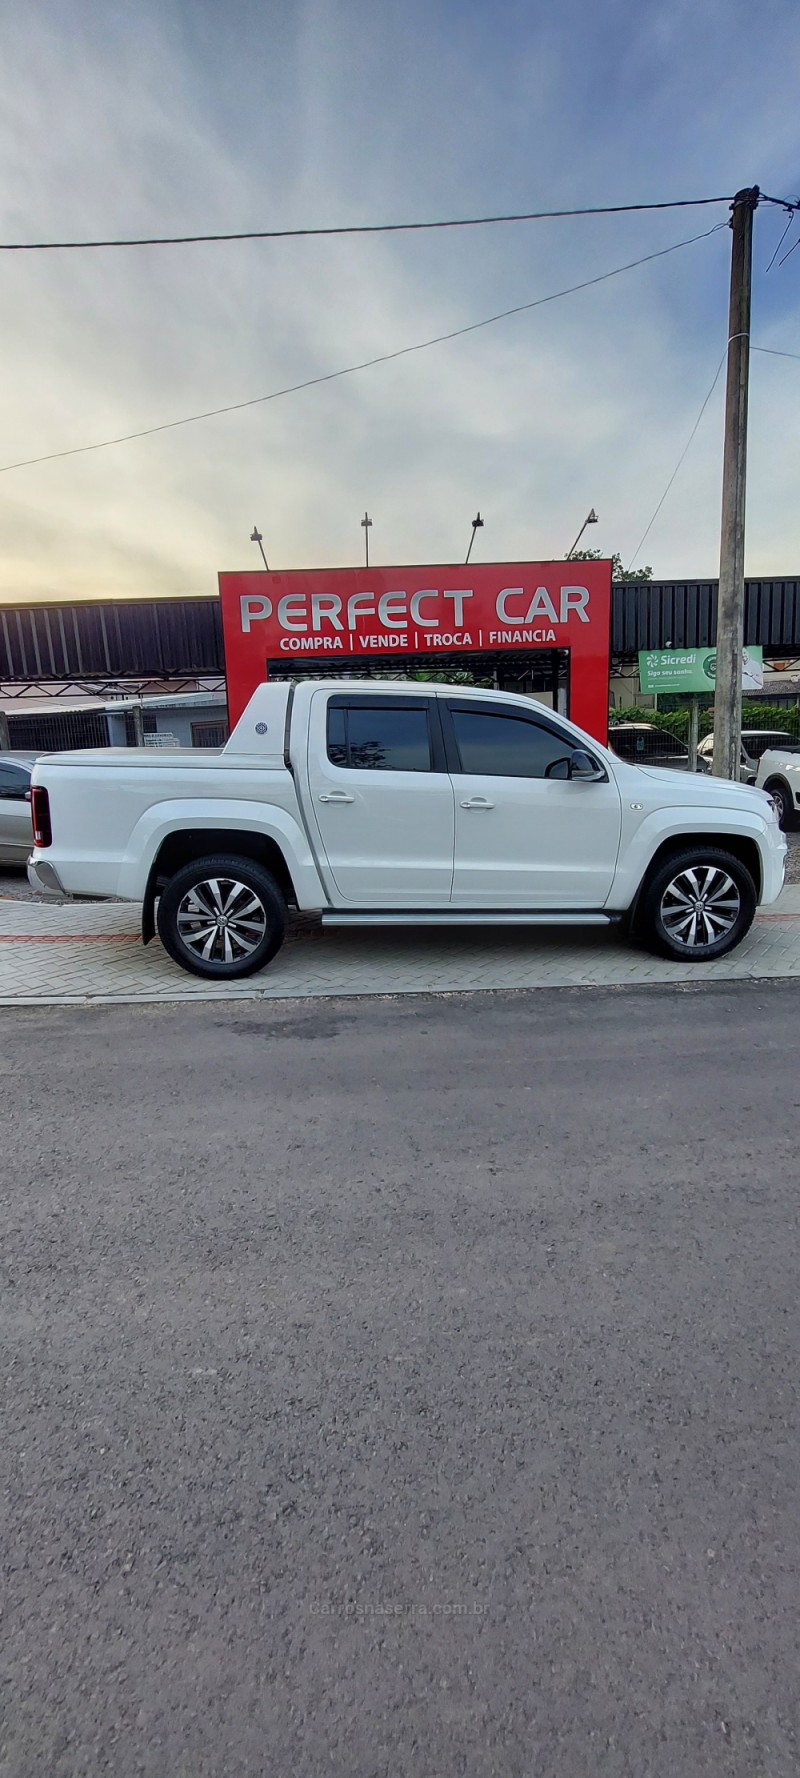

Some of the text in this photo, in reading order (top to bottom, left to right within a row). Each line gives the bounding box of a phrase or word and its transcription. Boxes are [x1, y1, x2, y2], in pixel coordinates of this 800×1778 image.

[239, 586, 591, 633] PERFECT CAR
[279, 629, 556, 651] COMPRA VENDE TROCA FINANCIA
[660, 653, 696, 665] Sicredi
